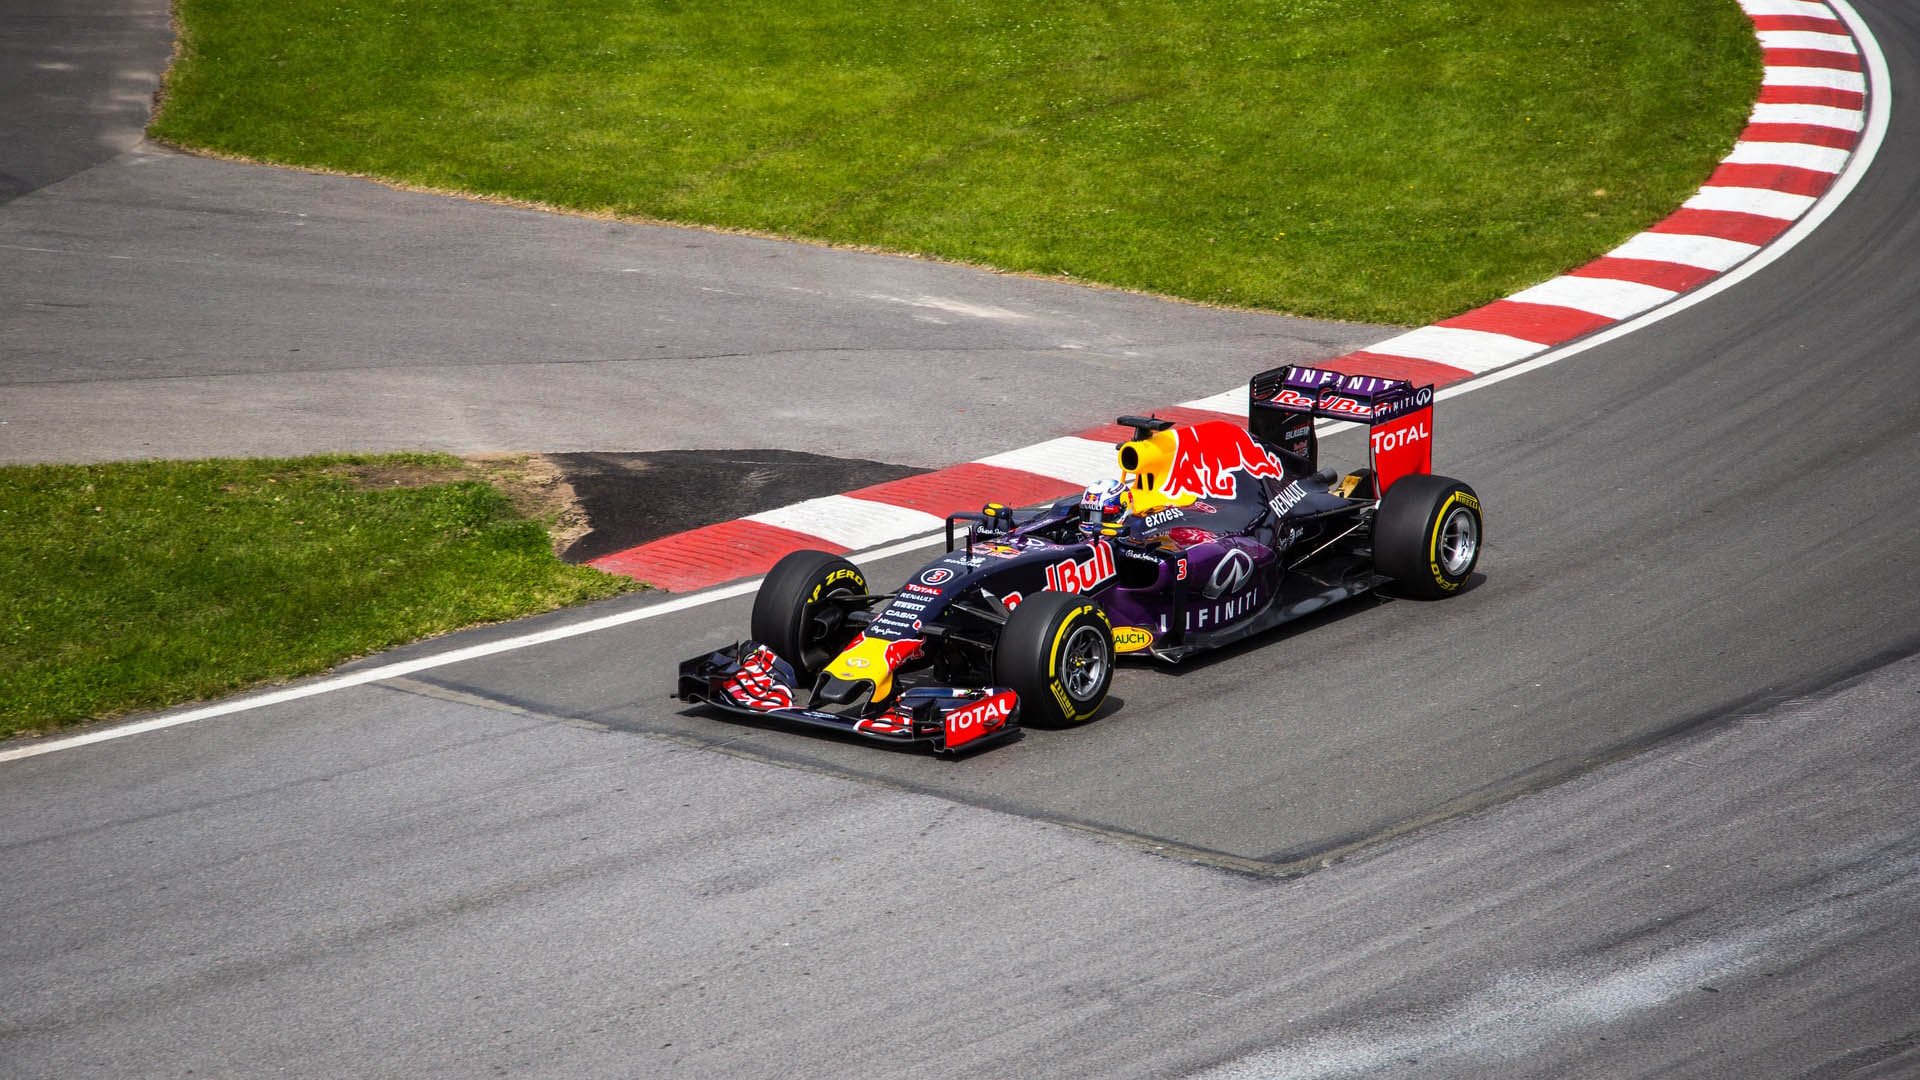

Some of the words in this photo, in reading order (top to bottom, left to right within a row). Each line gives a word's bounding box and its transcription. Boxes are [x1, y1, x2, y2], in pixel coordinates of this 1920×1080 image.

[1287, 367, 1406, 391] INFINIT
[1371, 423, 1428, 454] TOTAL
[1269, 480, 1308, 518] RENAULT
[1145, 507, 1184, 528] exness
[825, 568, 865, 587] ZERO
[926, 570, 947, 582] 3
[1056, 540, 1117, 596] Bull
[1176, 558, 1188, 581] 3
[900, 592, 935, 603] RENAULT
[907, 583, 940, 595] TOTAL
[877, 617, 910, 628] Hisense
[885, 609, 919, 620] CASIO
[1114, 633, 1145, 644] AUCH
[946, 699, 1012, 732] TOTAL
